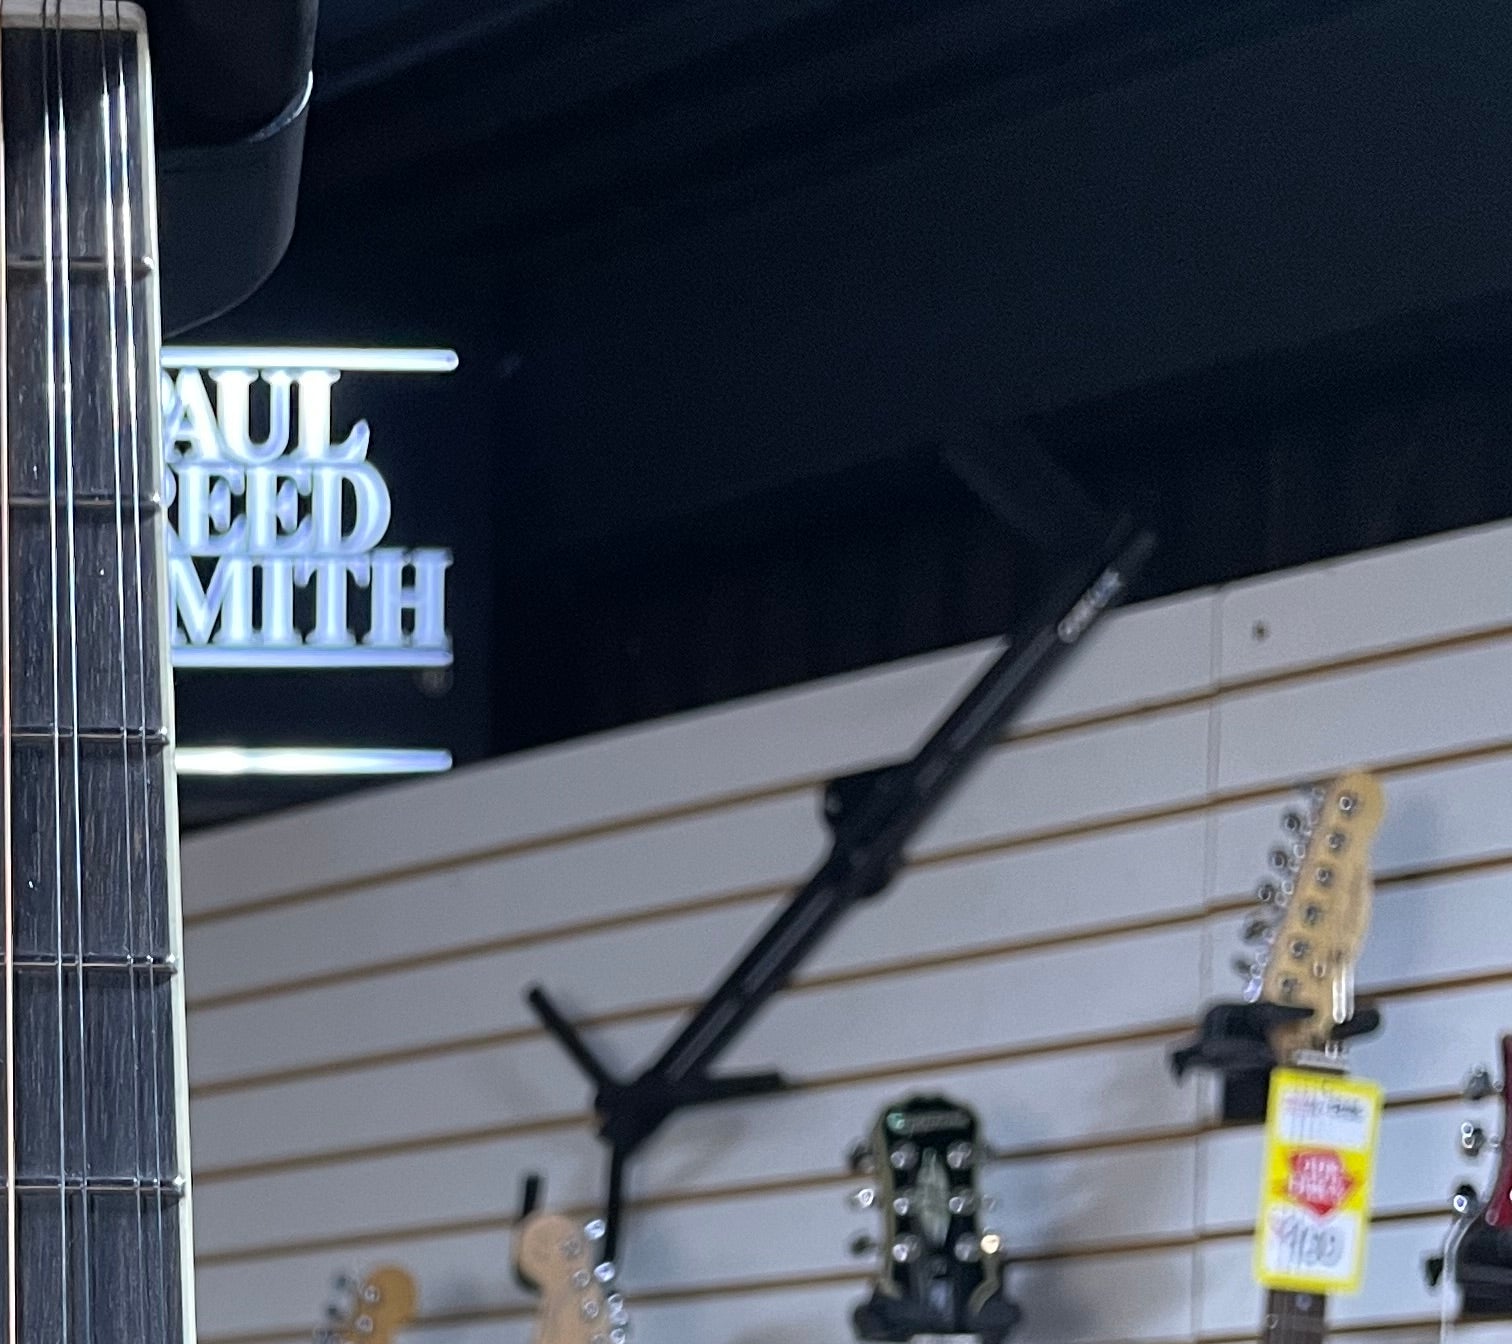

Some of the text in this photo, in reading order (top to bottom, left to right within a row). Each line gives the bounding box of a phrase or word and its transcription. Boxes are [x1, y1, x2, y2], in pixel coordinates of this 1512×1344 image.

[160, 366, 370, 464] AUL
[162, 462, 391, 557] EED
[169, 547, 455, 648] MITH
